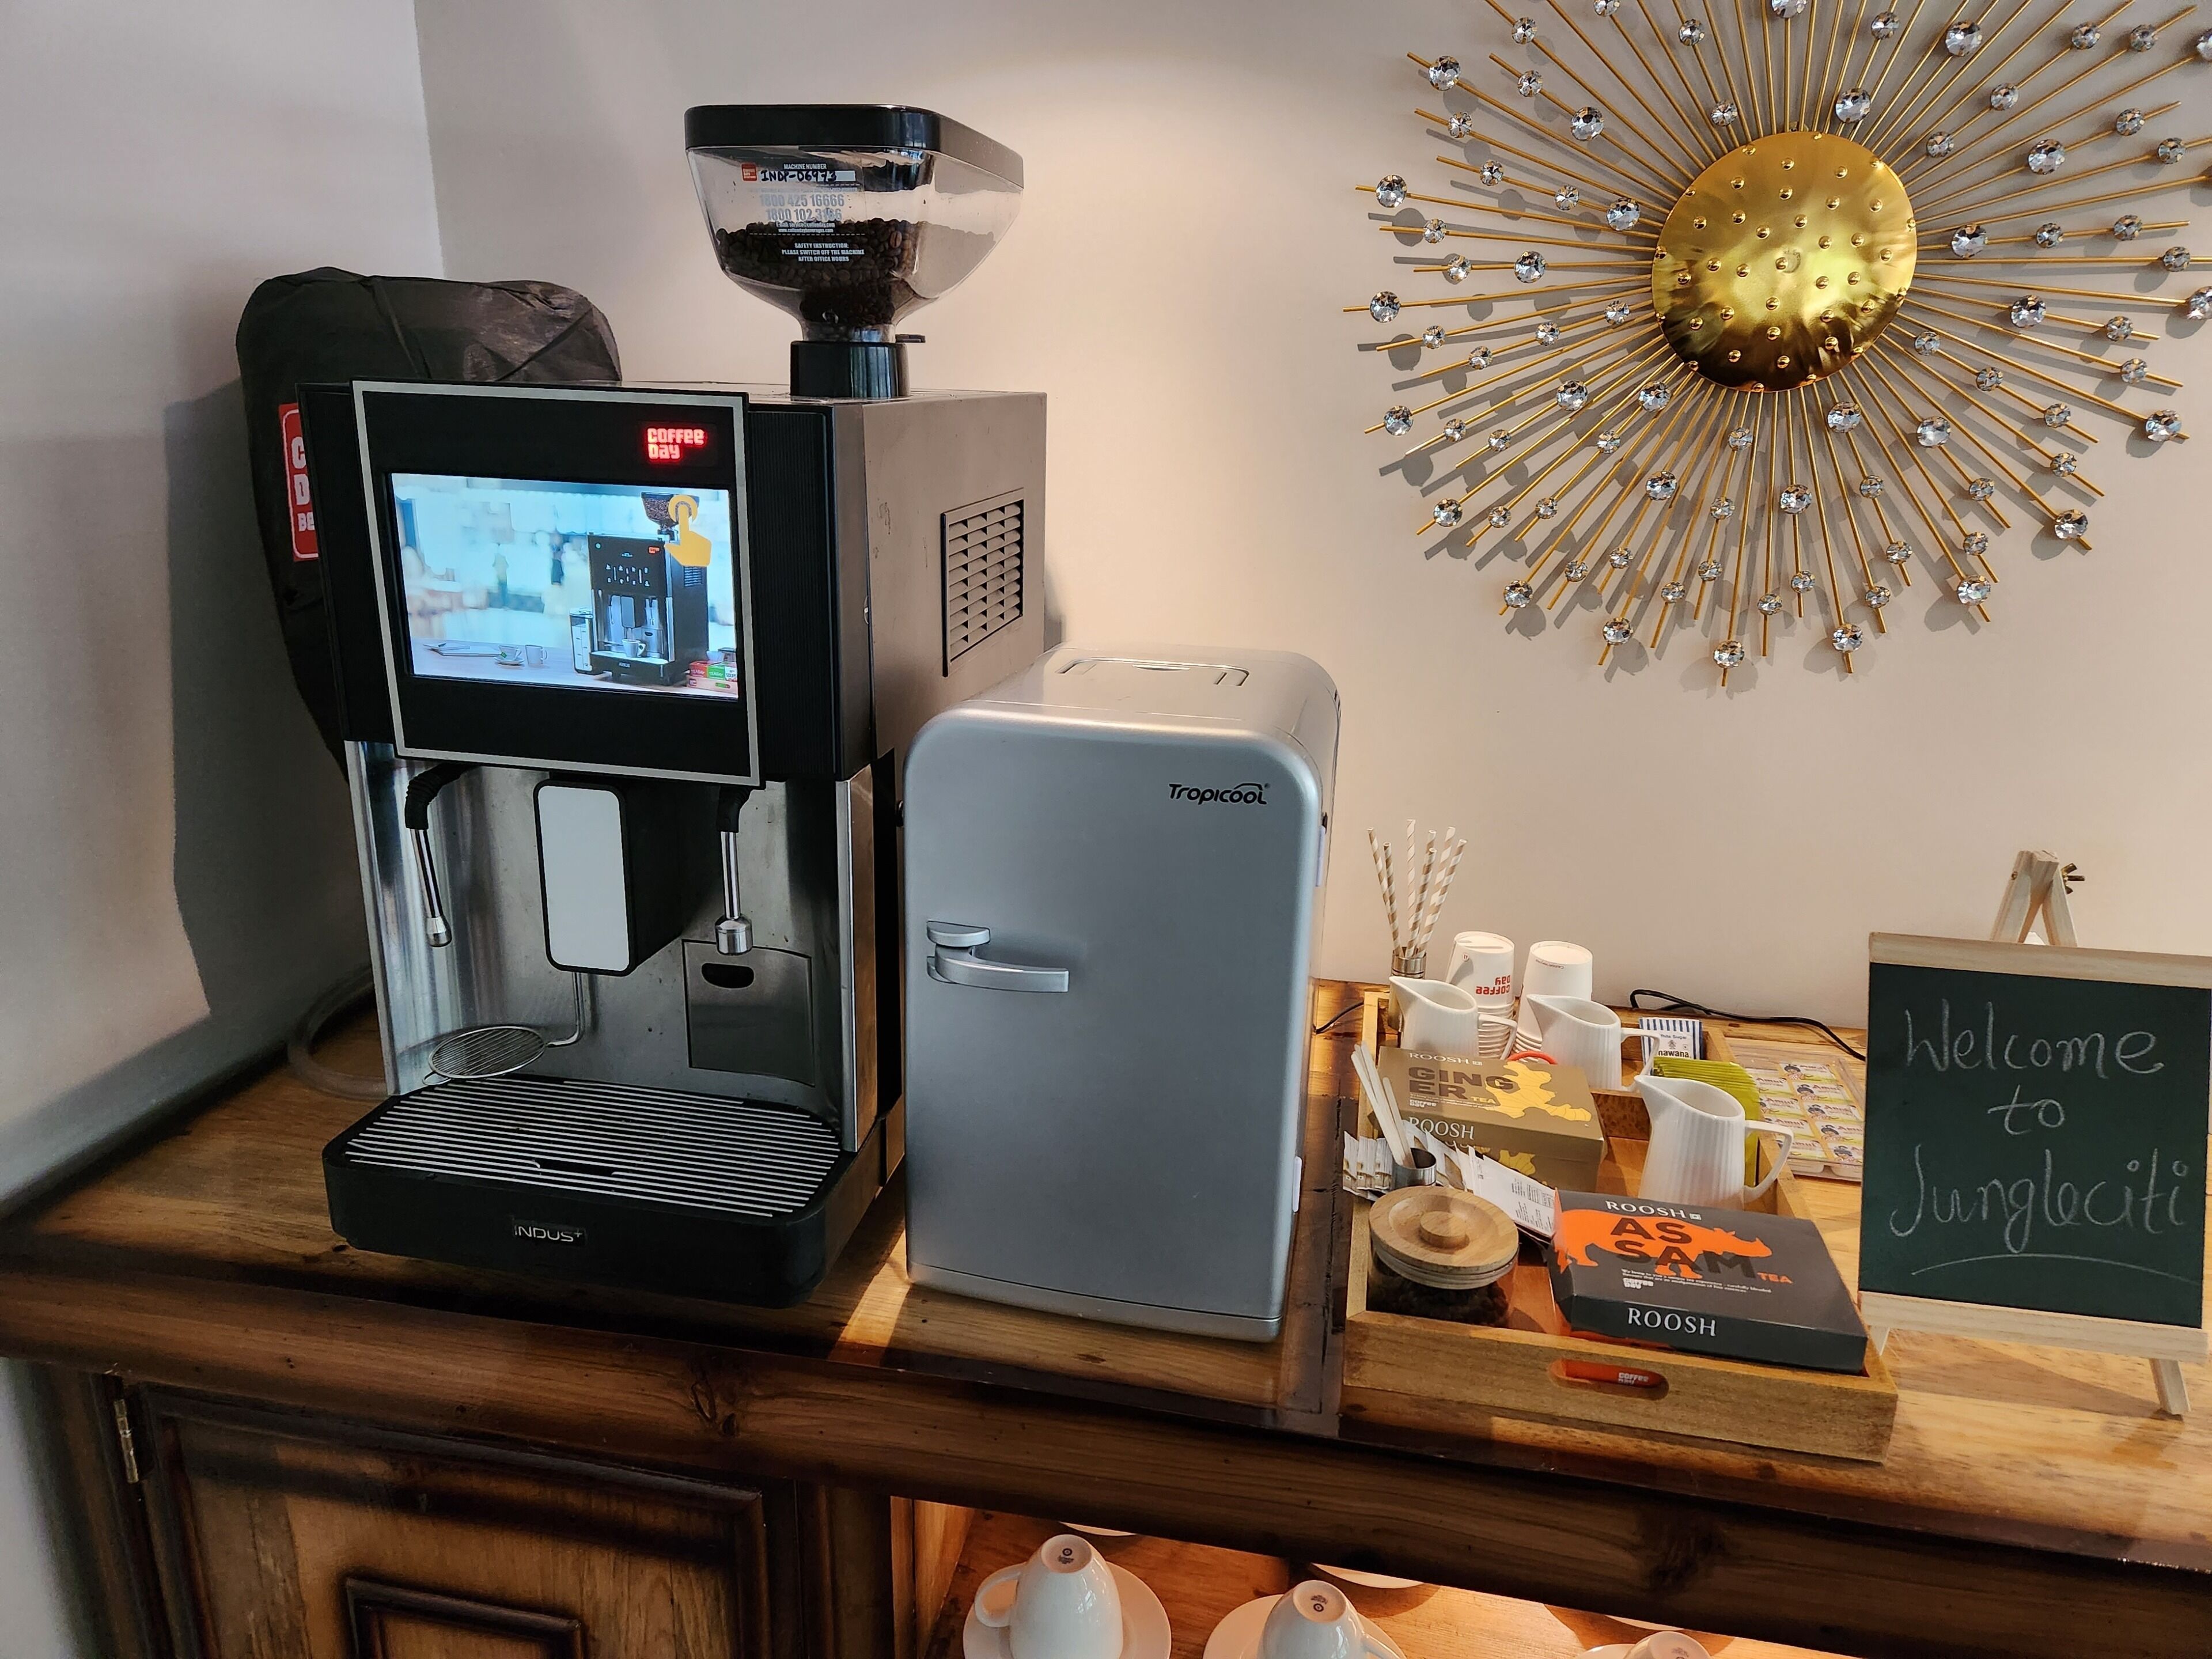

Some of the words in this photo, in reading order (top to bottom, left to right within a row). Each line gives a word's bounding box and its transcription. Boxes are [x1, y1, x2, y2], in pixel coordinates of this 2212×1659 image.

[1905, 998, 2165, 1080] Welcome
[1409, 1052, 1469, 1065] ROOSH
[1470, 1096, 1497, 1104] TEA
[1987, 1085, 2066, 1135] to
[1605, 1200, 1687, 1218] ROOSH
[1889, 1143, 2189, 1253] Jungleciti
[1611, 1217, 1692, 1244] AS
[1614, 1240, 1756, 1279] SAM
[1757, 1271, 1793, 1284] TEA
[1627, 1307, 1717, 1337] ROOSH
